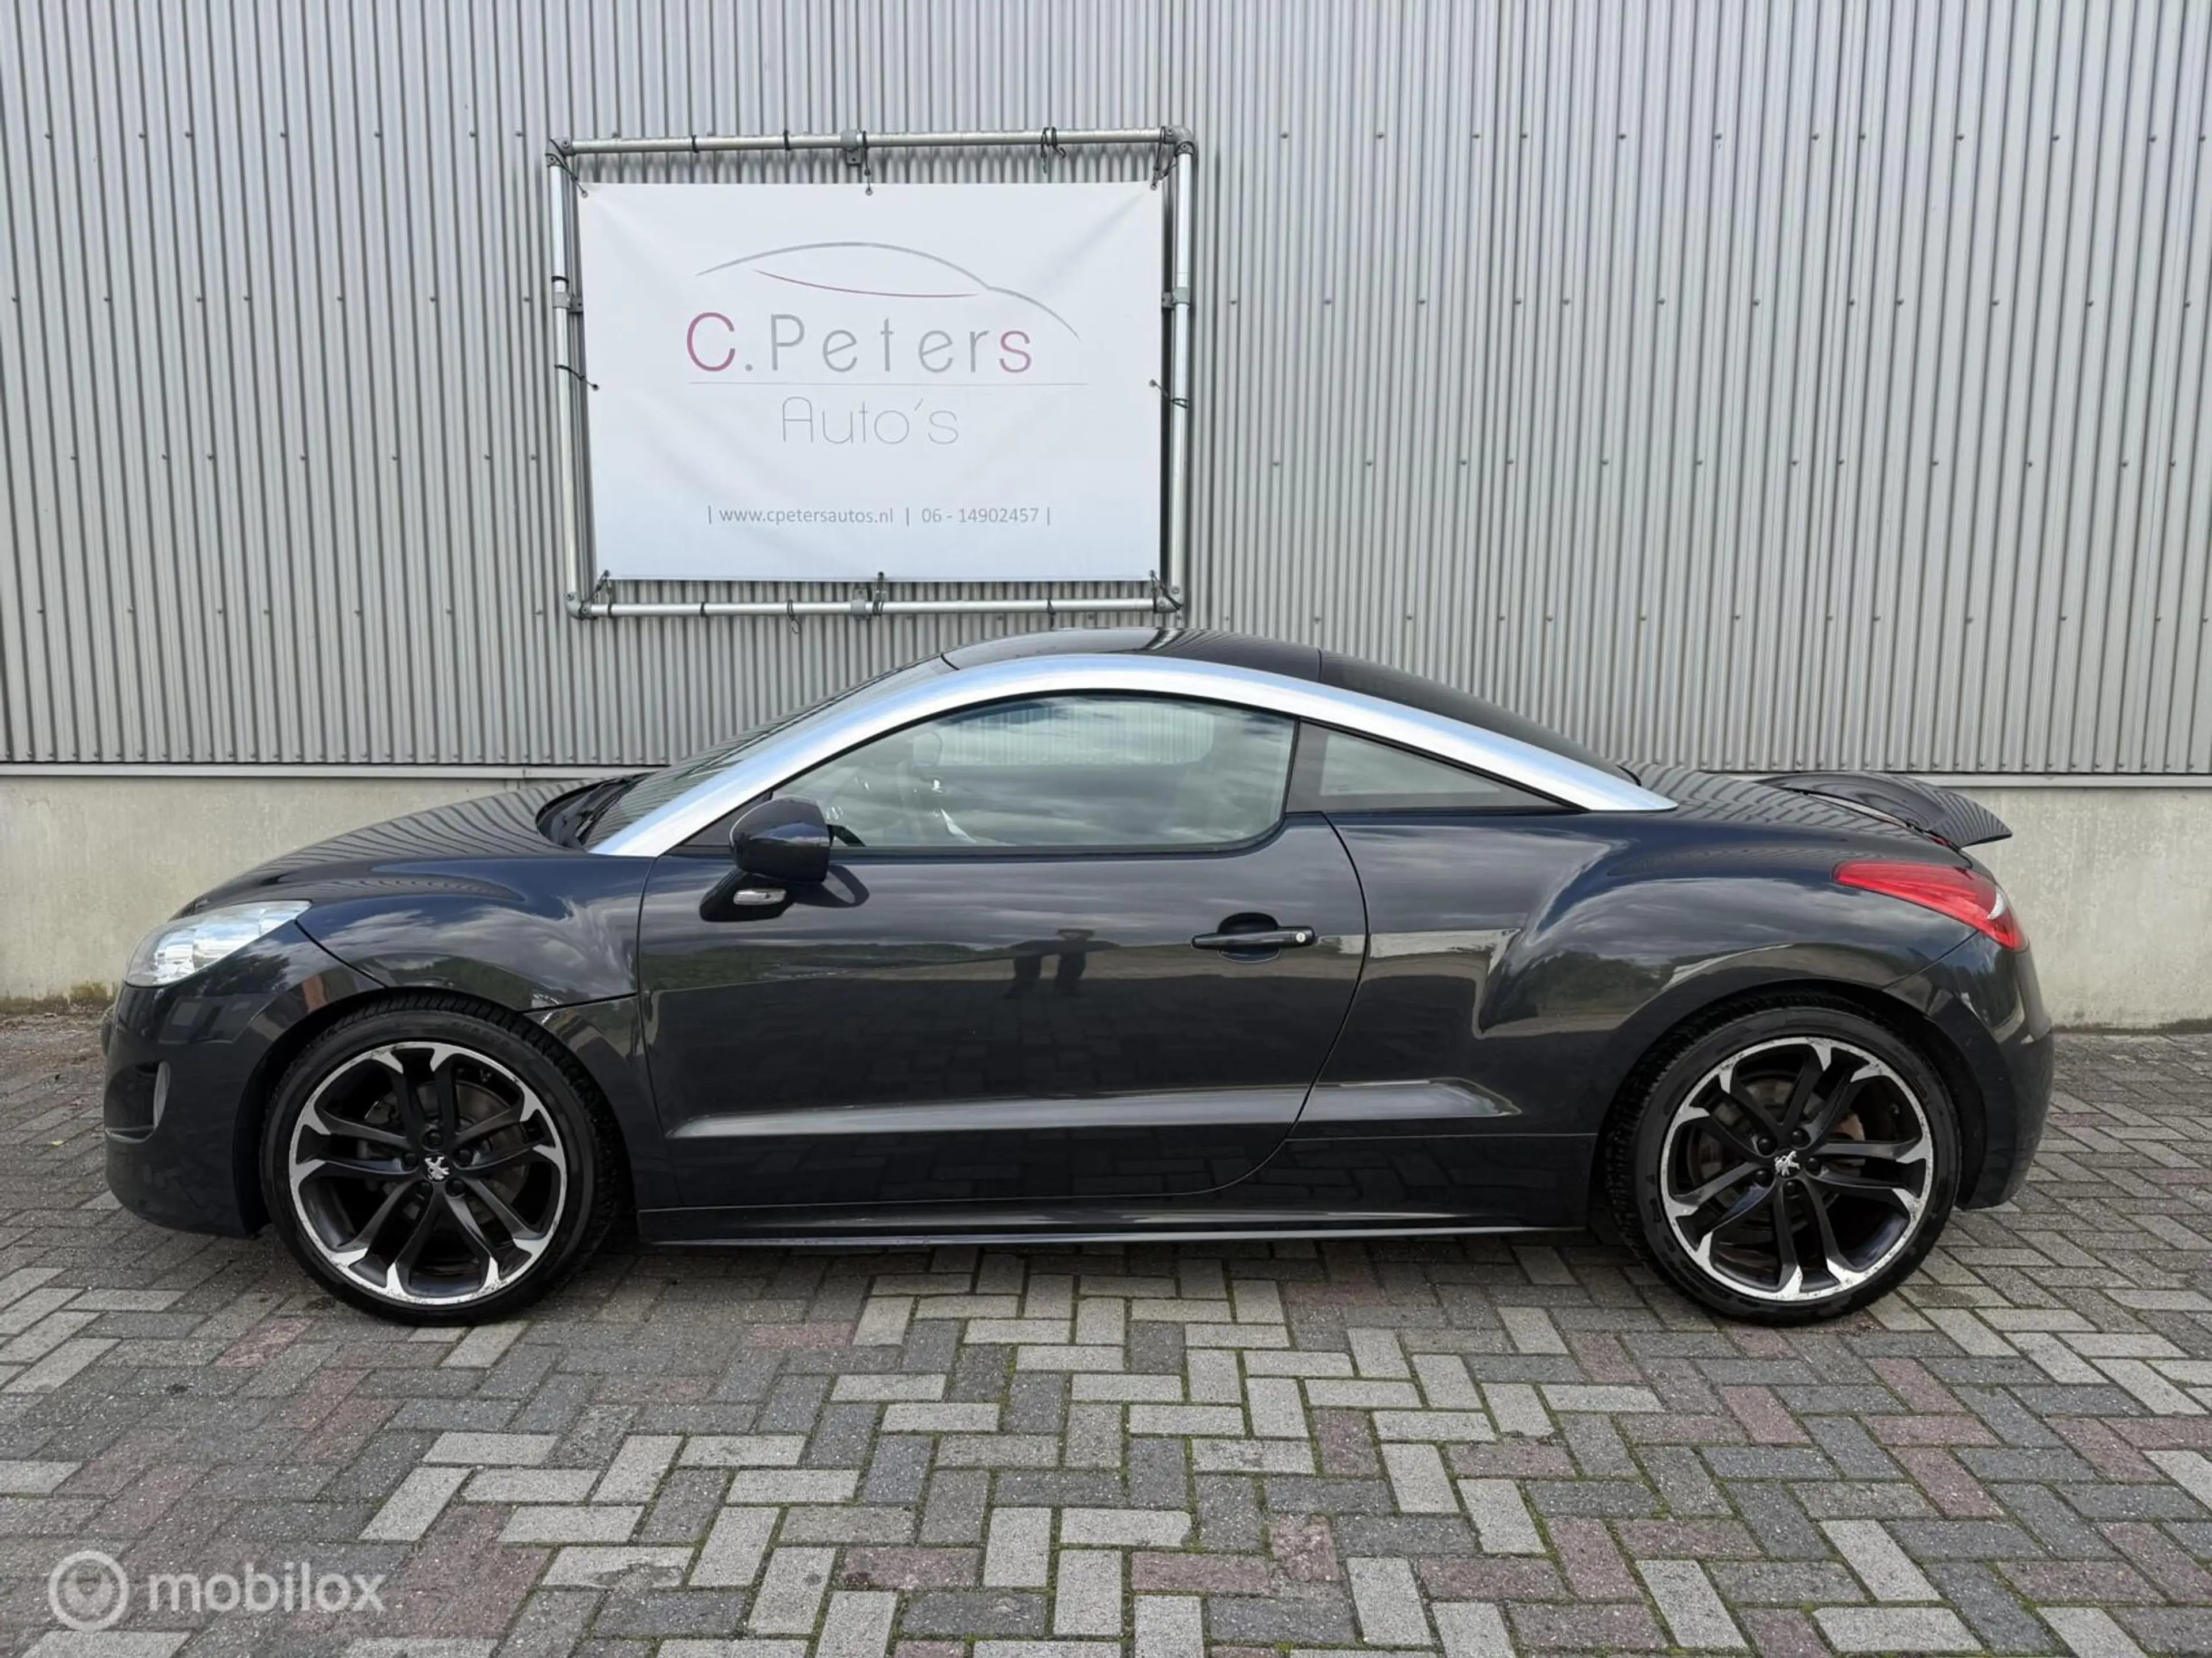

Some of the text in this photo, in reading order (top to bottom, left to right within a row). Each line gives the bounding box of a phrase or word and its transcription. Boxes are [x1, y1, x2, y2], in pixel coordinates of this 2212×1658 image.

[686, 312, 1032, 373] C.Peters
[719, 507, 893, 525] www.cpetersautos.nl
[922, 508, 942, 523] 06
[959, 507, 1039, 523] 14902457
